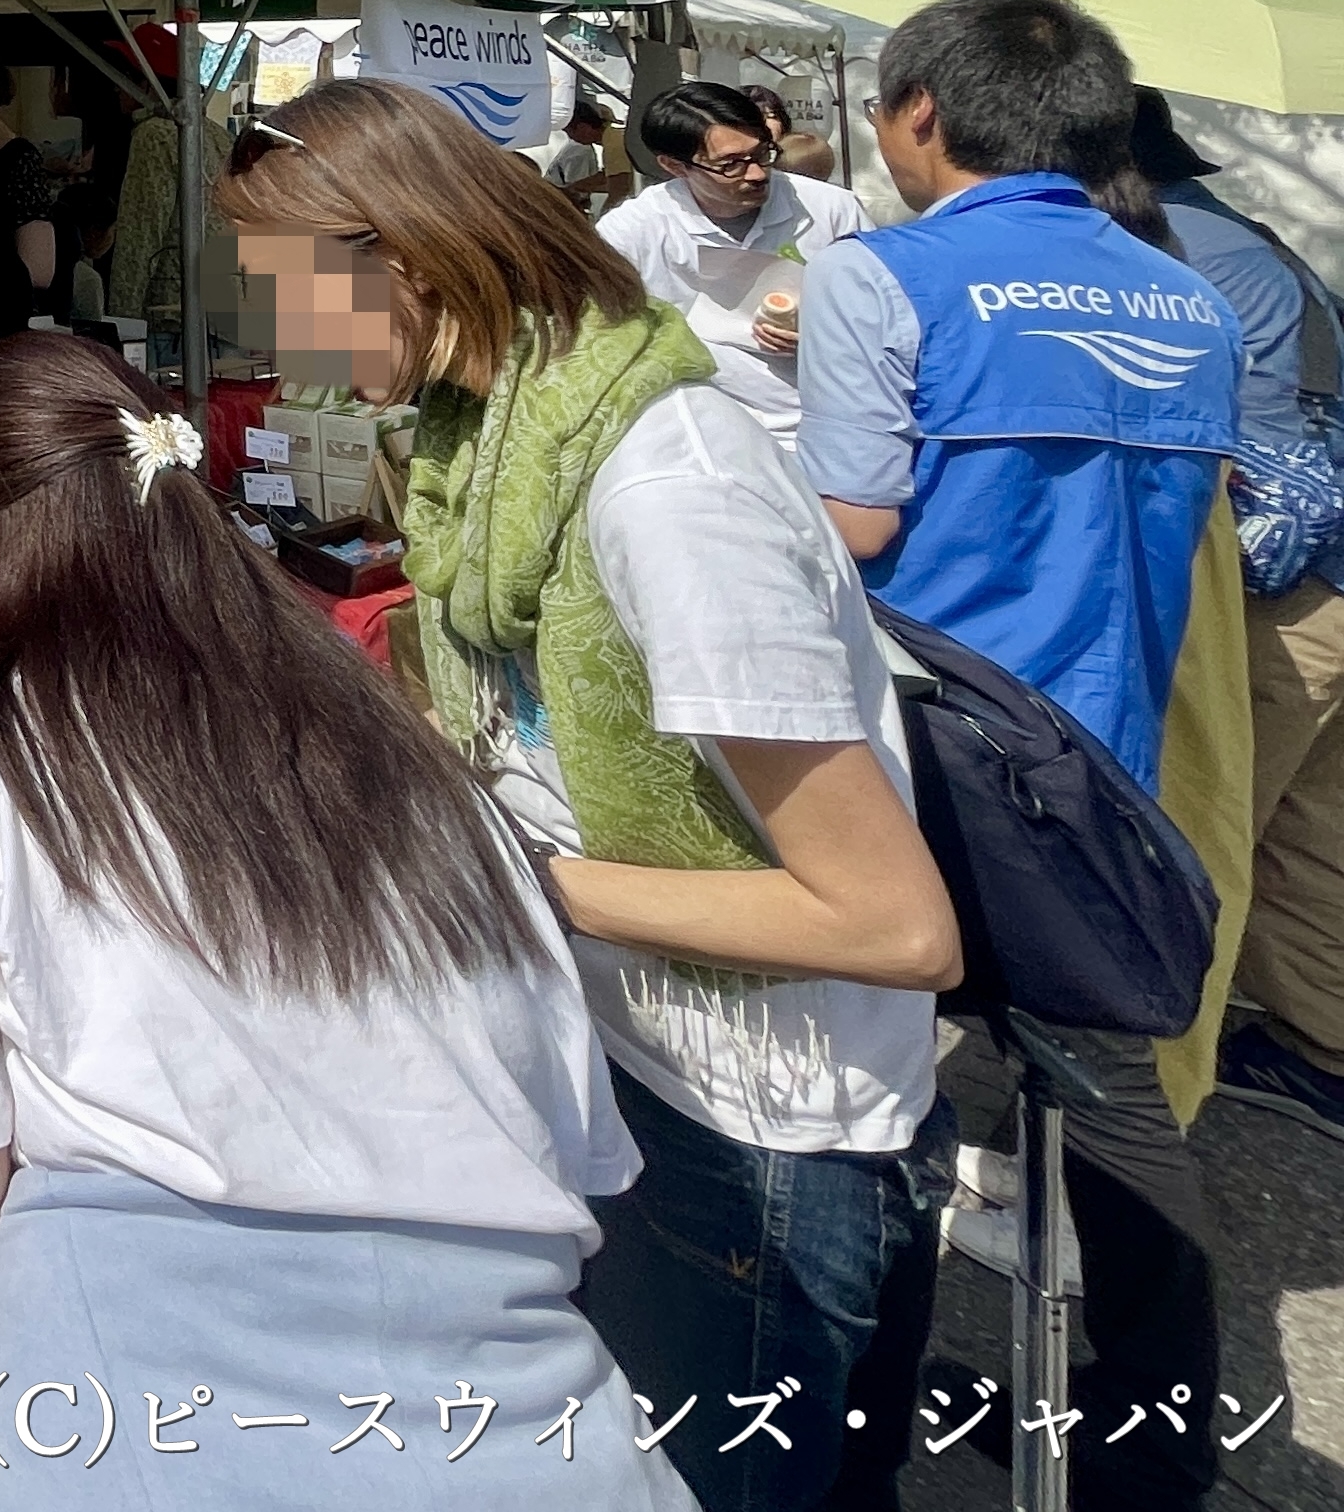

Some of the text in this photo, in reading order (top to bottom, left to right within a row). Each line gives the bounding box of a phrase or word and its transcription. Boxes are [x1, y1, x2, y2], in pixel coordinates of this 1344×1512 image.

[403, 19, 532, 66] peace winds
[968, 282, 1221, 328] peace winds
